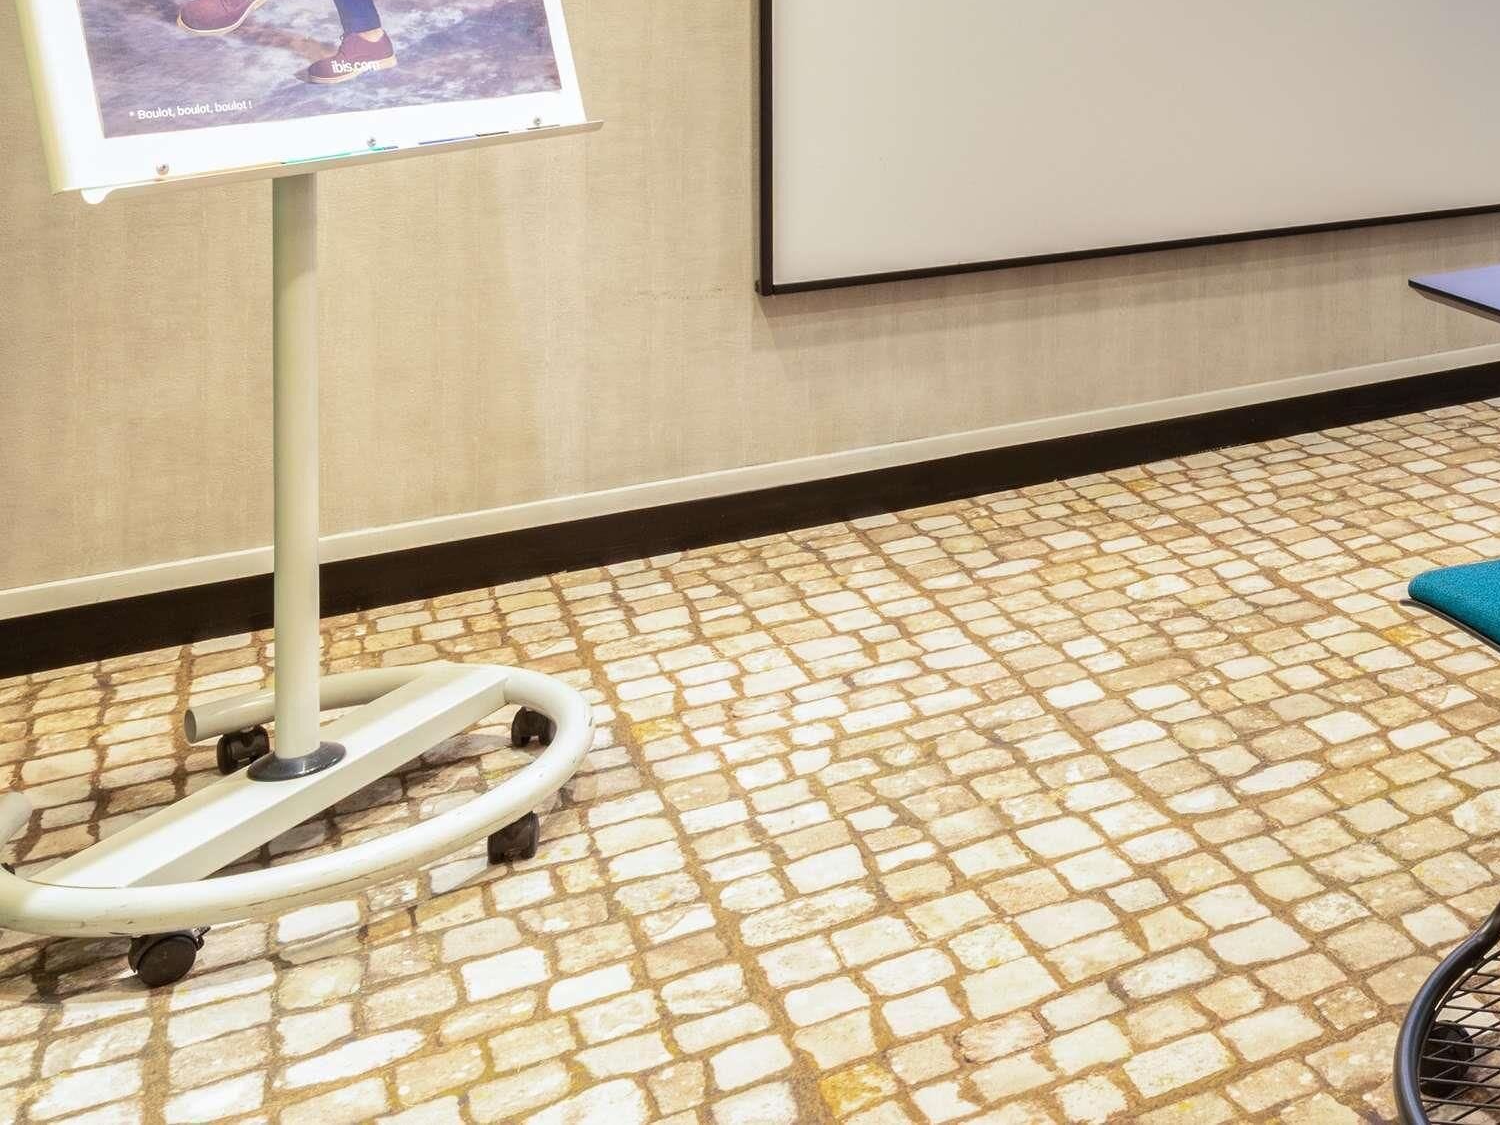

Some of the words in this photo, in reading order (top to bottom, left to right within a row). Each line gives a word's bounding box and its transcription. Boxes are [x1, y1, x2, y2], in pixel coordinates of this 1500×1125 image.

[330, 59, 381, 74] ibis.com
[137, 107, 176, 120] Boulot,
[176, 103, 213, 116] boulot,
